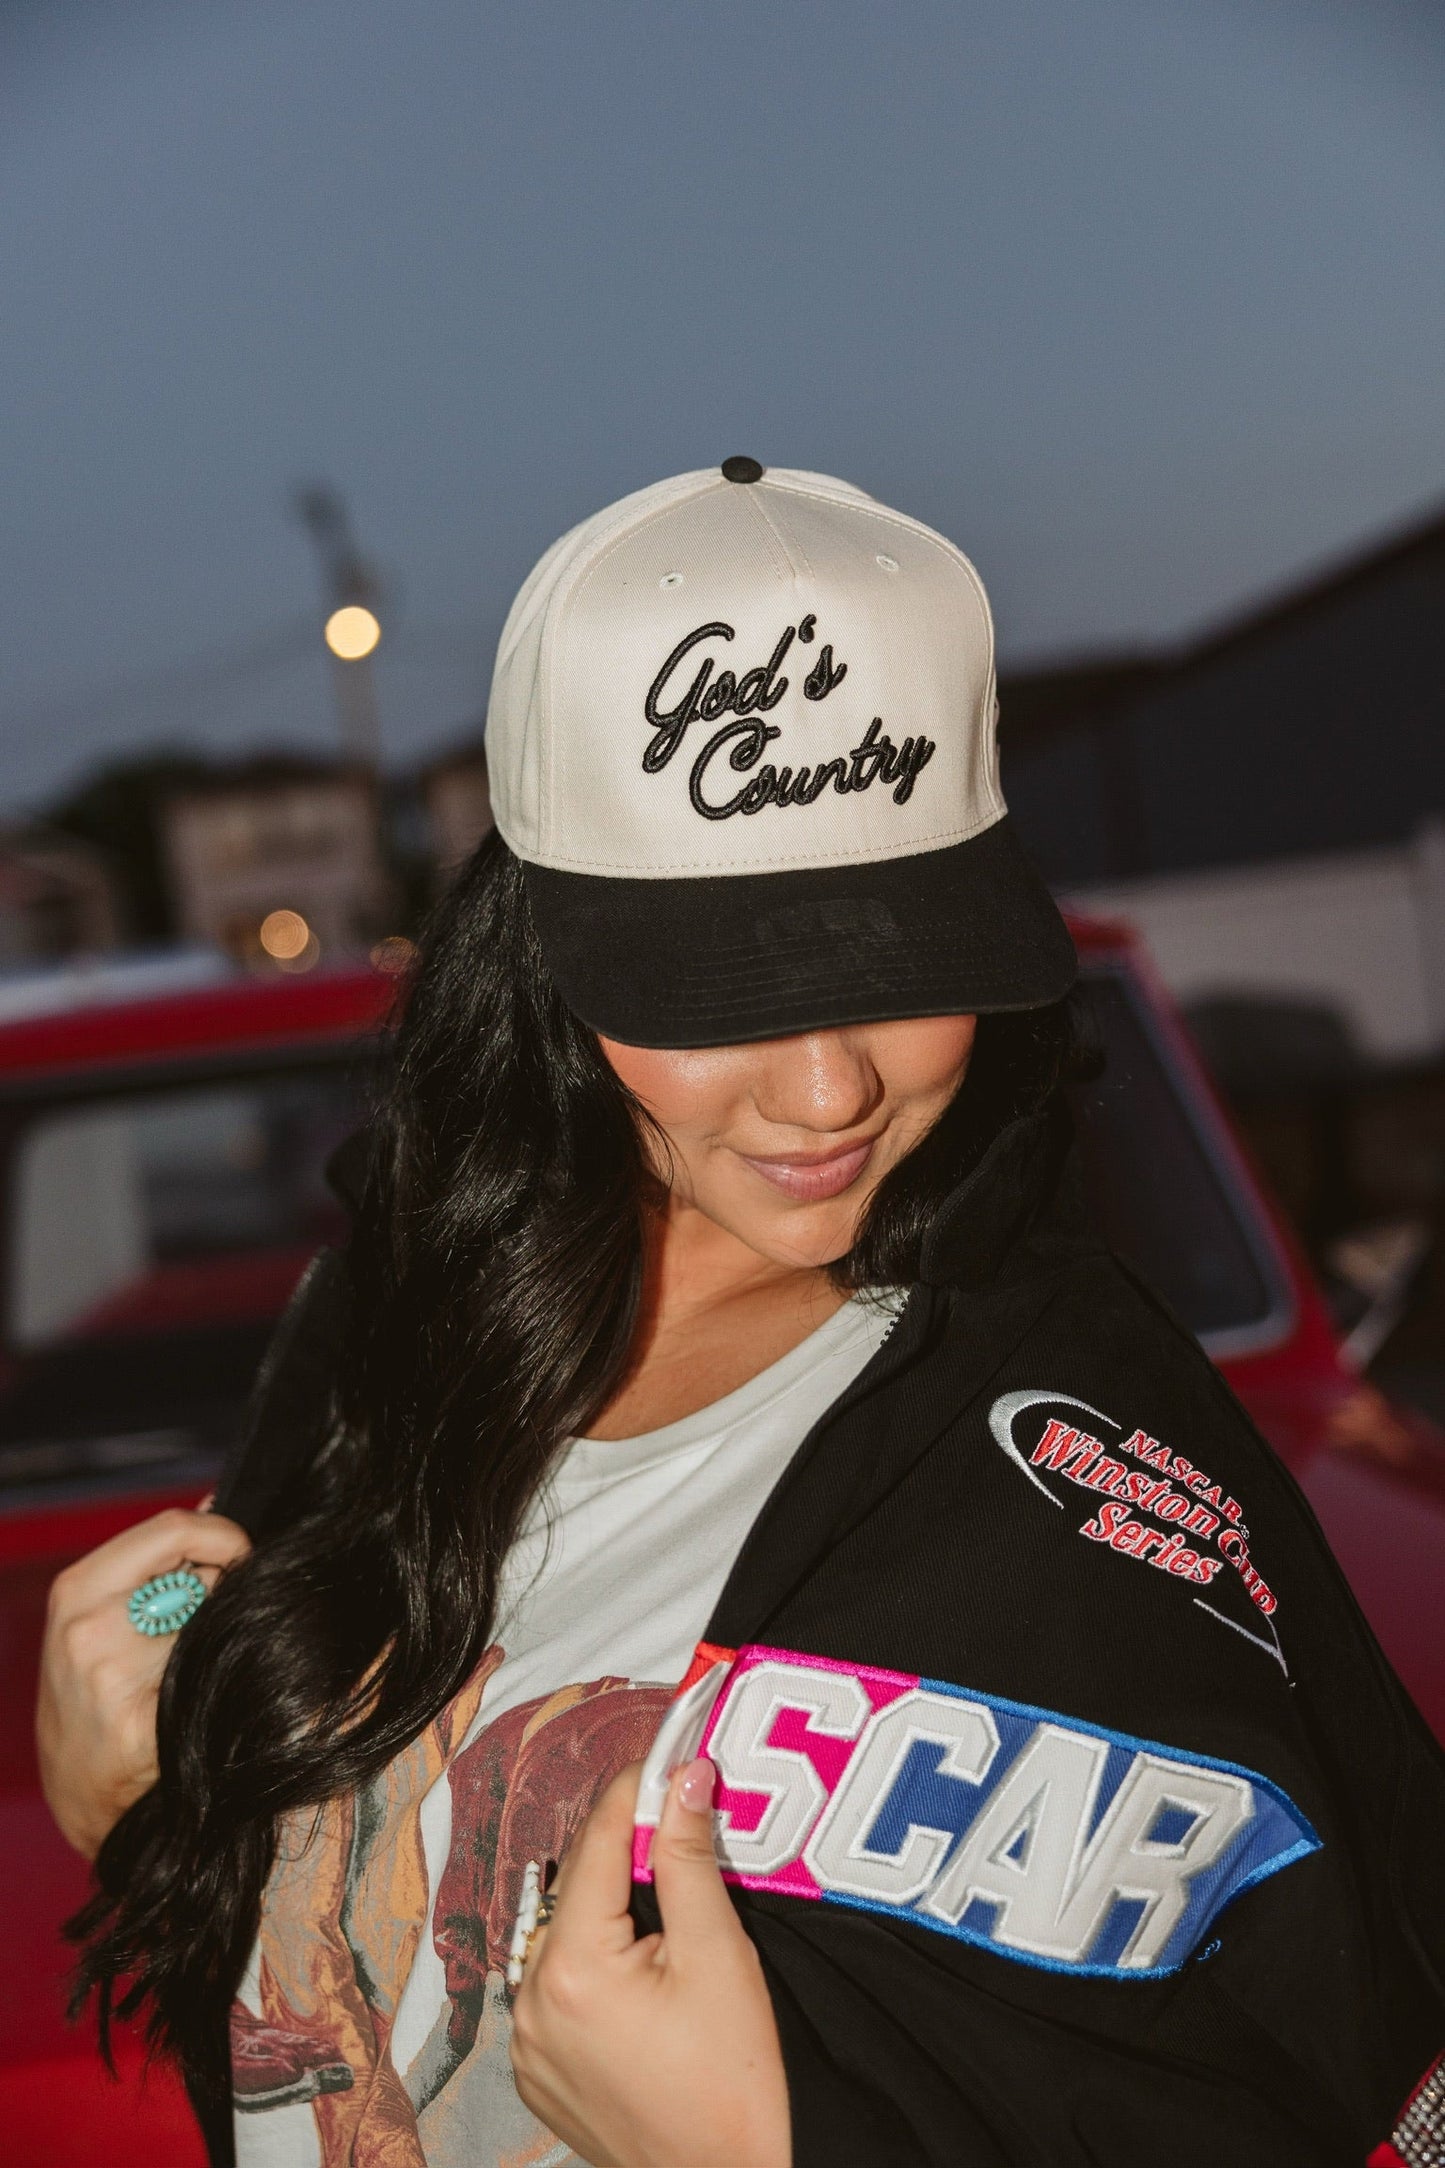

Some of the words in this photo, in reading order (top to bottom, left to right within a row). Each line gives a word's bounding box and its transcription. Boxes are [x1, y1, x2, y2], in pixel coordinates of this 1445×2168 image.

[642, 613, 848, 774] God's
[689, 716, 937, 822] Country
[1028, 1417, 1220, 1540] Winston
[1217, 1527, 1278, 1615] Cup
[1078, 1500, 1224, 1585] Series
[1119, 1428, 1242, 1527] NASCAR
[636, 1660, 1256, 1969] SCAR
